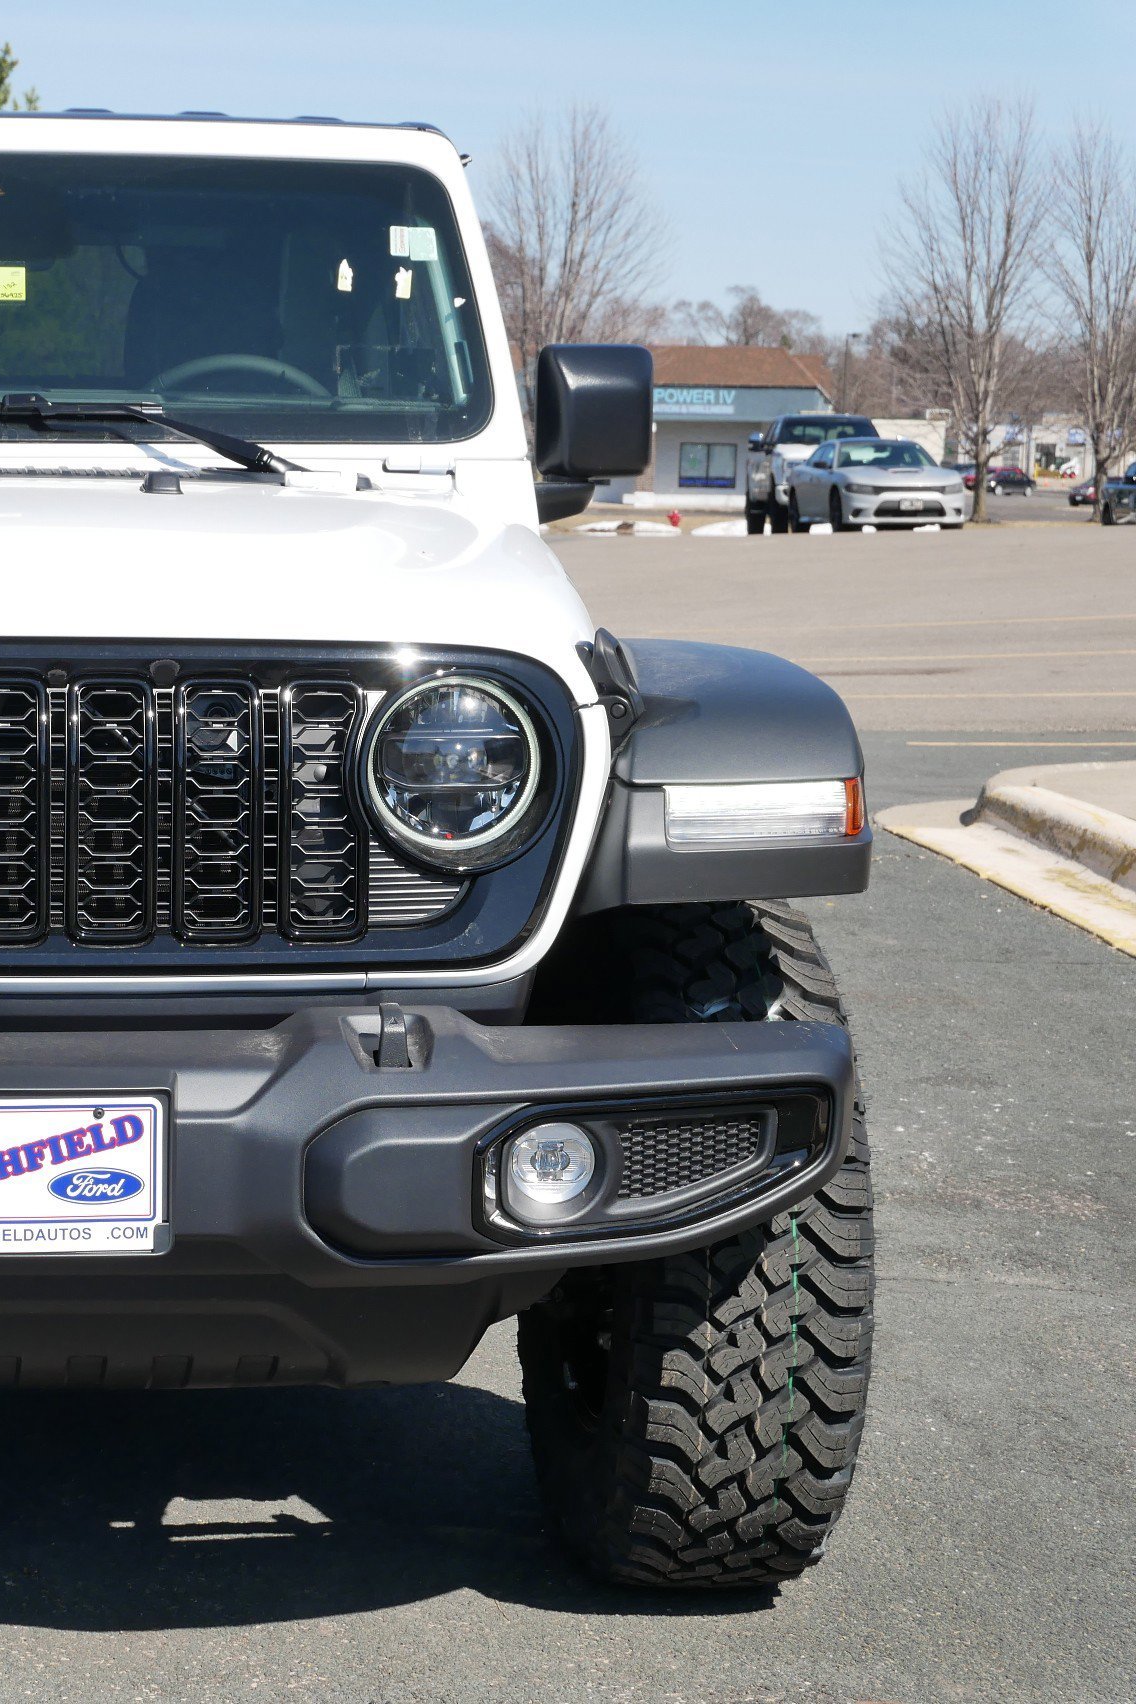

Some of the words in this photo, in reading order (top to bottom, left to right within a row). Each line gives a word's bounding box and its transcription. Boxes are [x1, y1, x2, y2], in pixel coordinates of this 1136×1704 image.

[654, 388, 715, 404] POWER
[719, 390, 736, 404] IV
[66, 1172, 124, 1197] Ford
[106, 1226, 149, 1240] .COM
